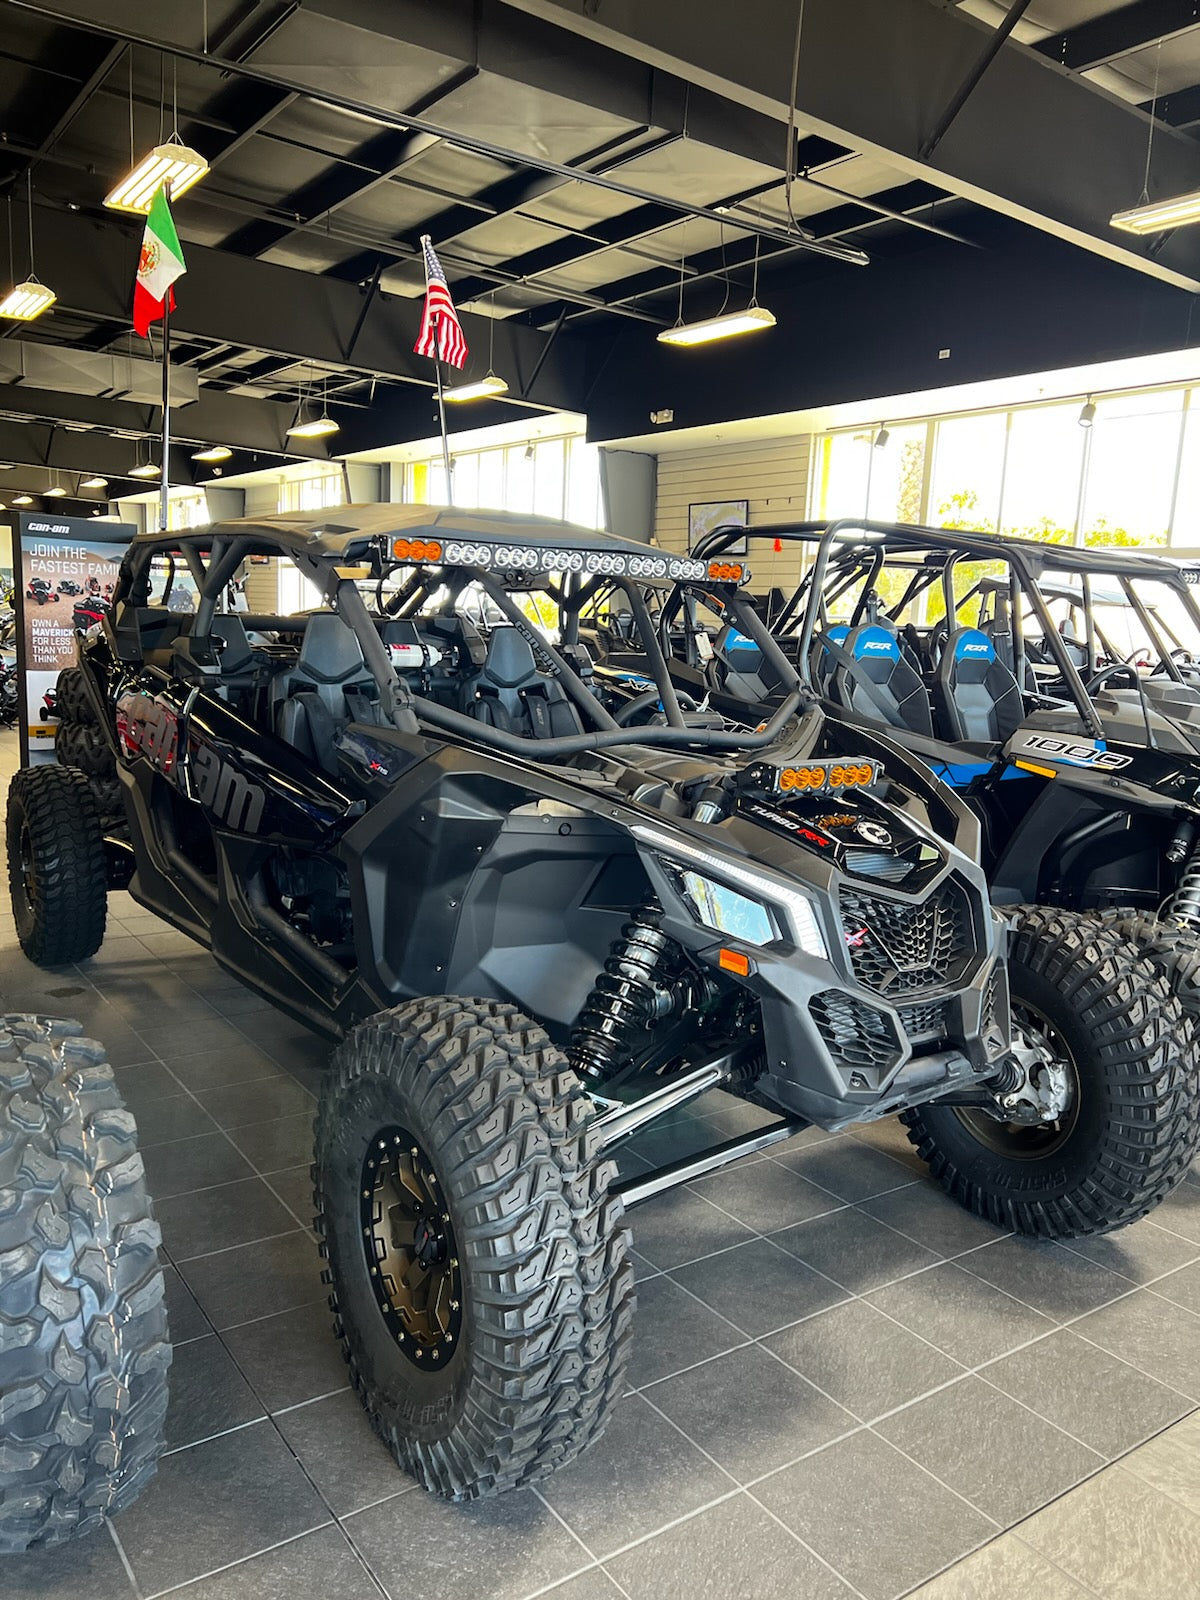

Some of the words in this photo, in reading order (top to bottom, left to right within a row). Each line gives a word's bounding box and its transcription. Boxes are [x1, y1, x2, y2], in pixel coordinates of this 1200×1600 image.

[28, 522, 70, 534] can-am
[30, 543, 60, 558] JOIN
[62, 546, 87, 560] THE
[30, 560, 85, 574] FASTEST
[31, 619, 52, 628] OWN
[52, 619, 60, 628] A
[32, 628, 74, 637] MAVERICK
[32, 636, 49, 645] FOR
[50, 637, 71, 646] LESS
[863, 641, 892, 651] RZR
[32, 645, 56, 654] THAN
[56, 646, 73, 655] YOU
[515, 621, 561, 675] can-am
[963, 643, 989, 653] RZR
[33, 654, 59, 663] THINK
[1023, 735, 1134, 769] 1000
[751, 805, 801, 830] TURBO
[797, 828, 830, 848] RR
